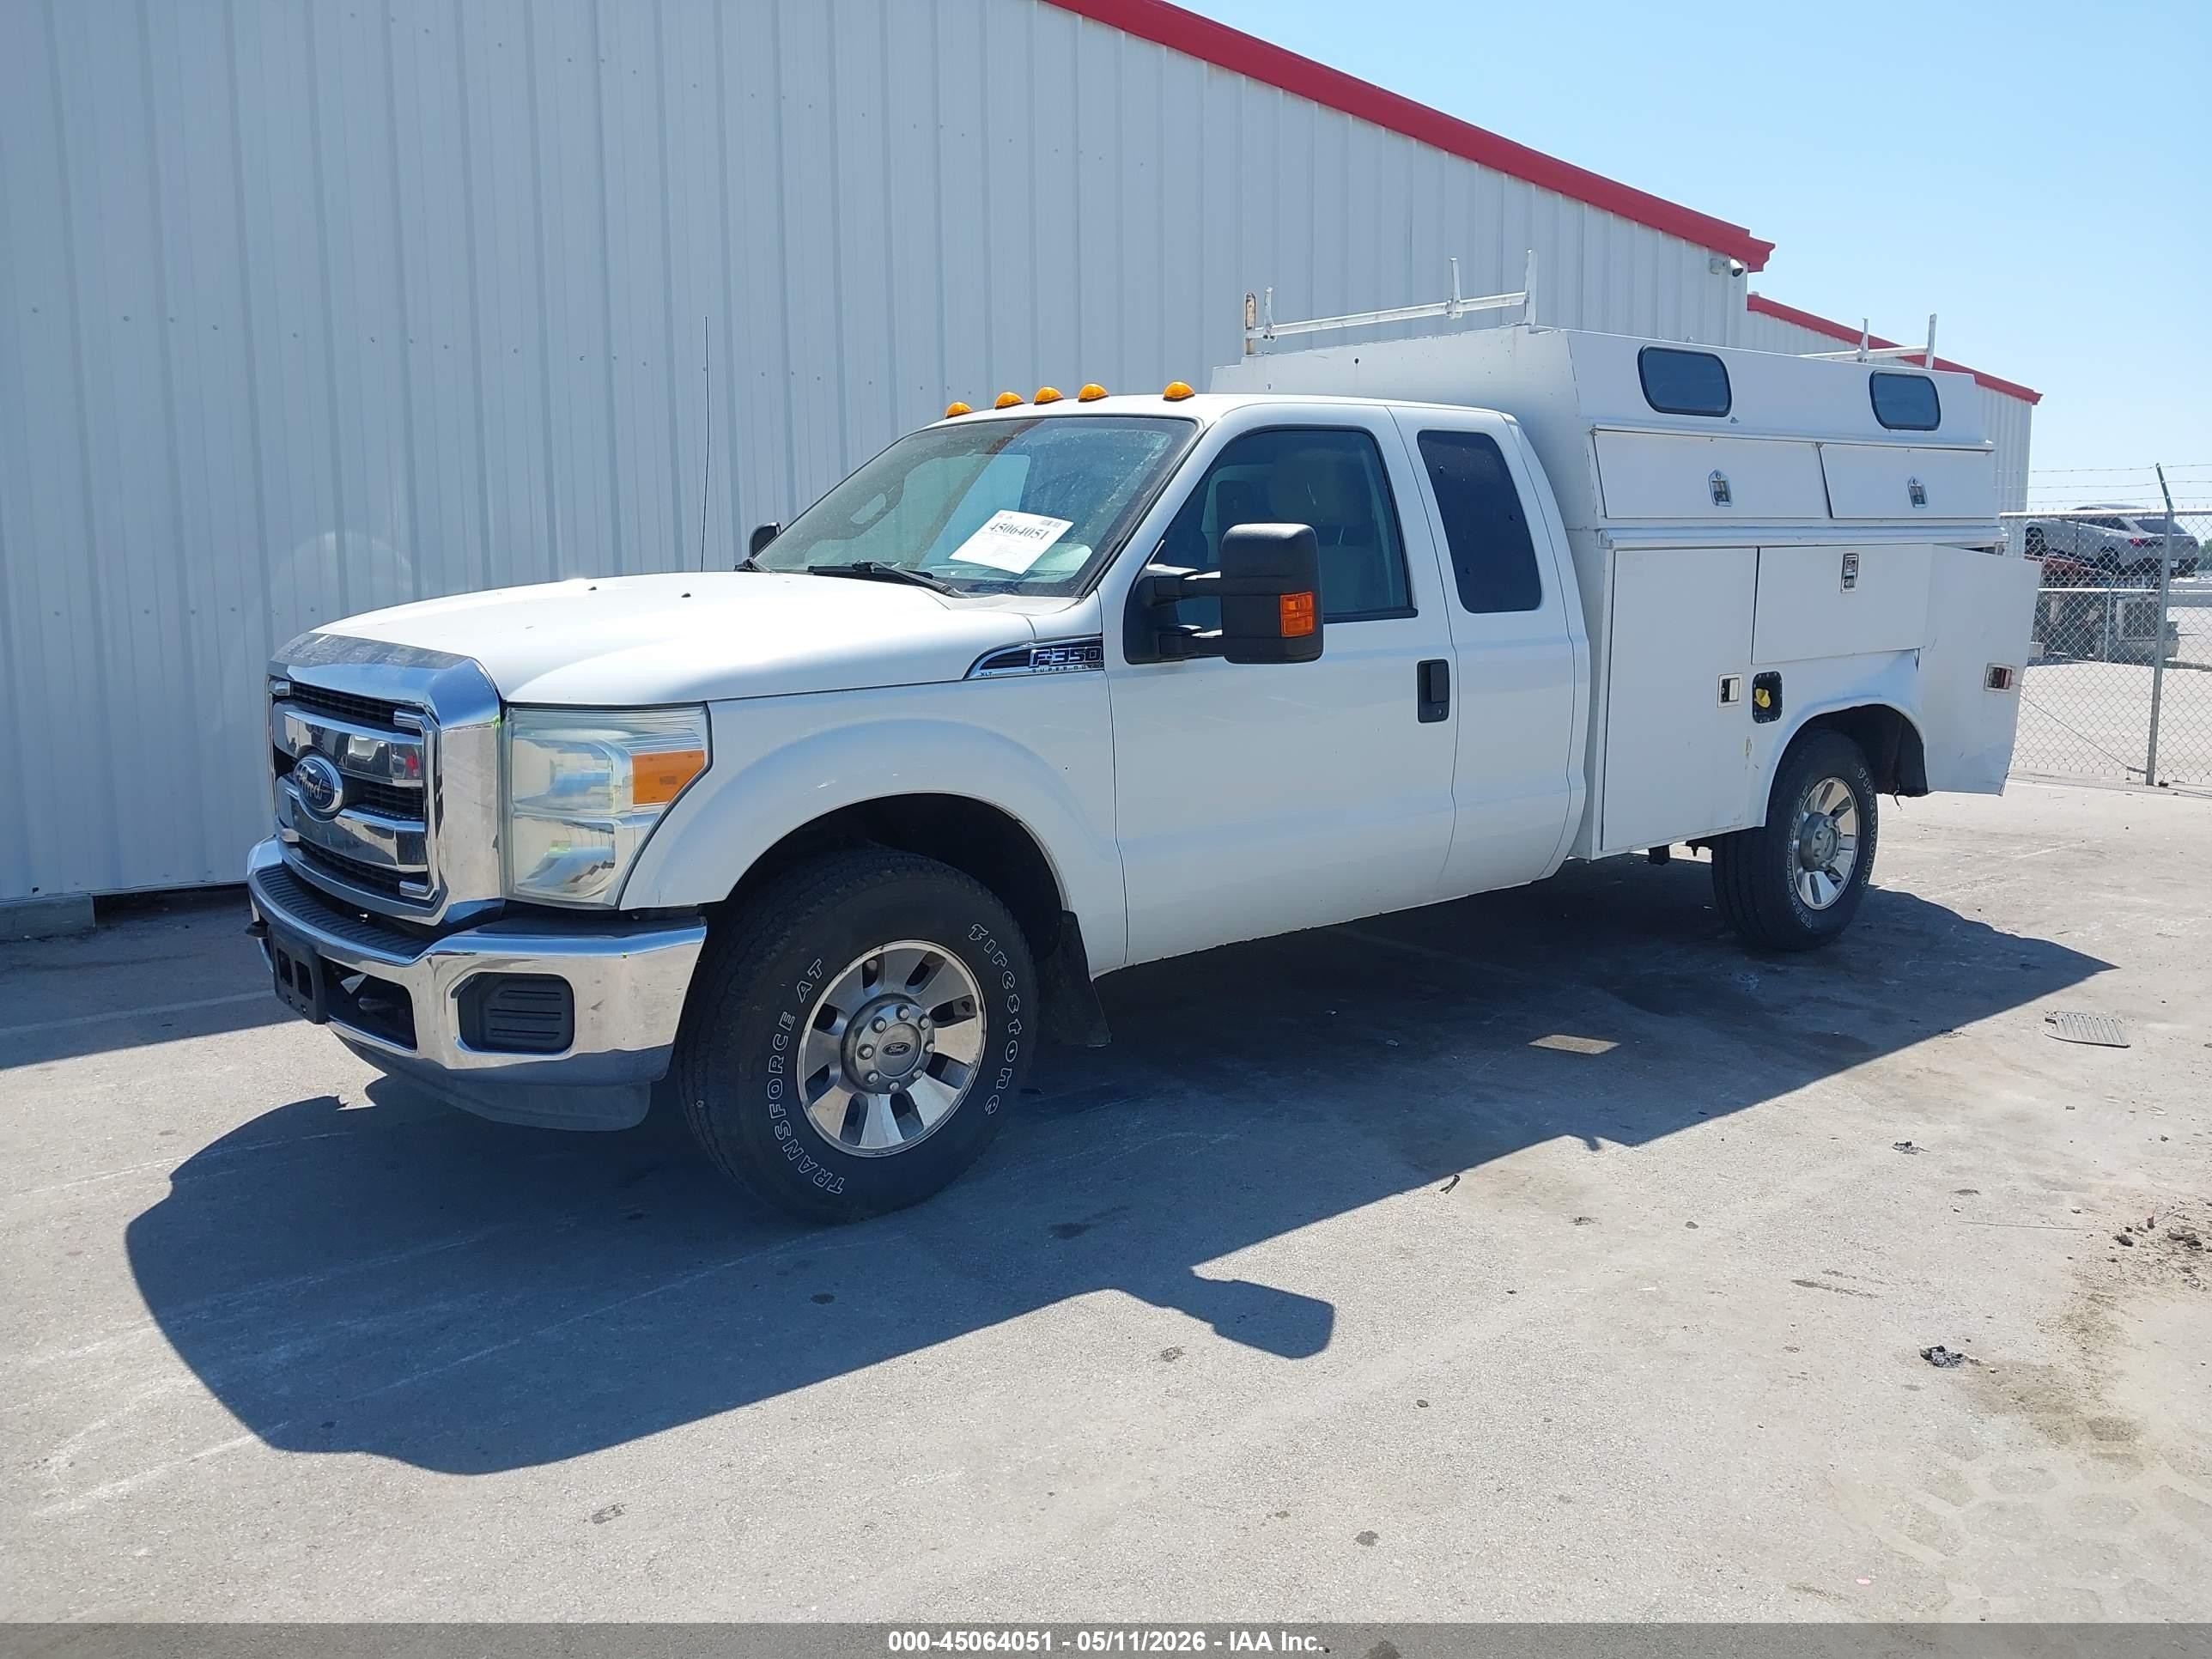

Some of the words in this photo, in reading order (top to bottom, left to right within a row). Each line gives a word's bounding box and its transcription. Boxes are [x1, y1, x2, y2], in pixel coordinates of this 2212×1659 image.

[989, 522, 1049, 540] 45064051
[1030, 647, 1103, 667] F-350
[299, 764, 323, 800] Ford
[796, 958, 825, 1003] AT
[968, 923, 1023, 1115] Firestone
[767, 1011, 846, 1194] TRANSFORCE
